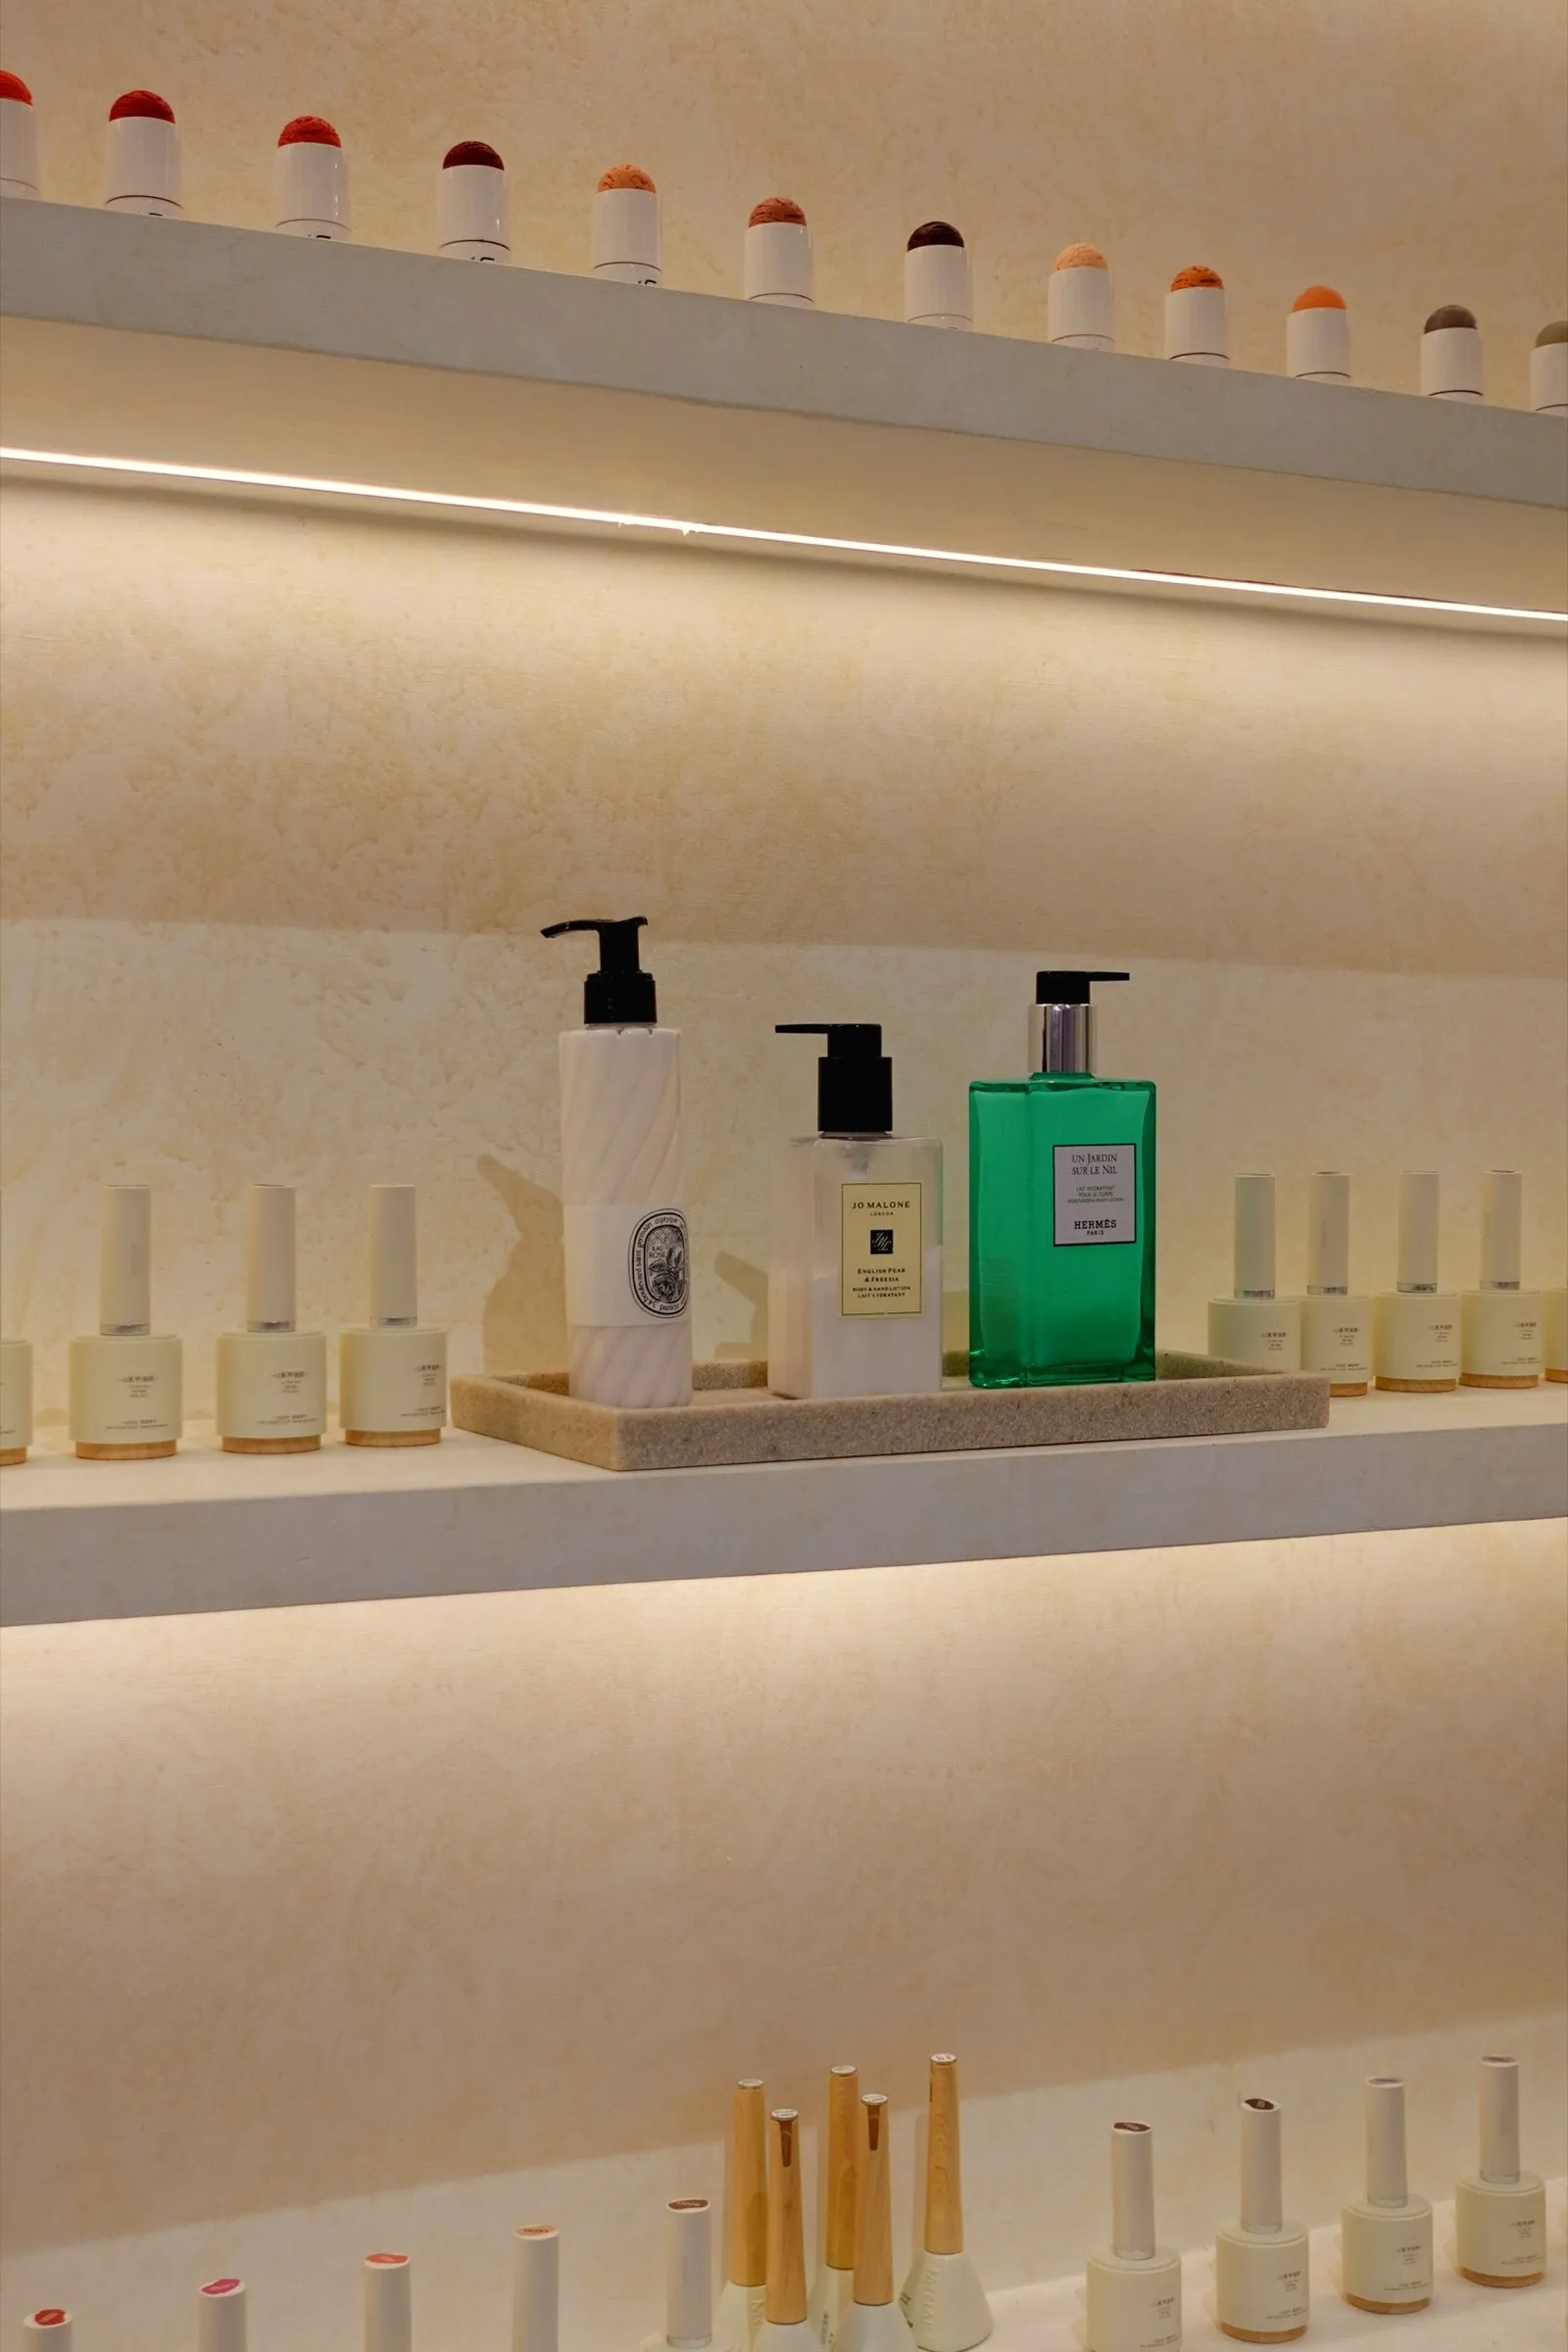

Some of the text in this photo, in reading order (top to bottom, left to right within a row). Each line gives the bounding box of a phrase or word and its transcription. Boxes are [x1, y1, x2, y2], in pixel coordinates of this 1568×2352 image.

[1072, 1152, 1117, 1165] UN JARDIN
[1072, 1164, 1117, 1175] SUR LE NIL
